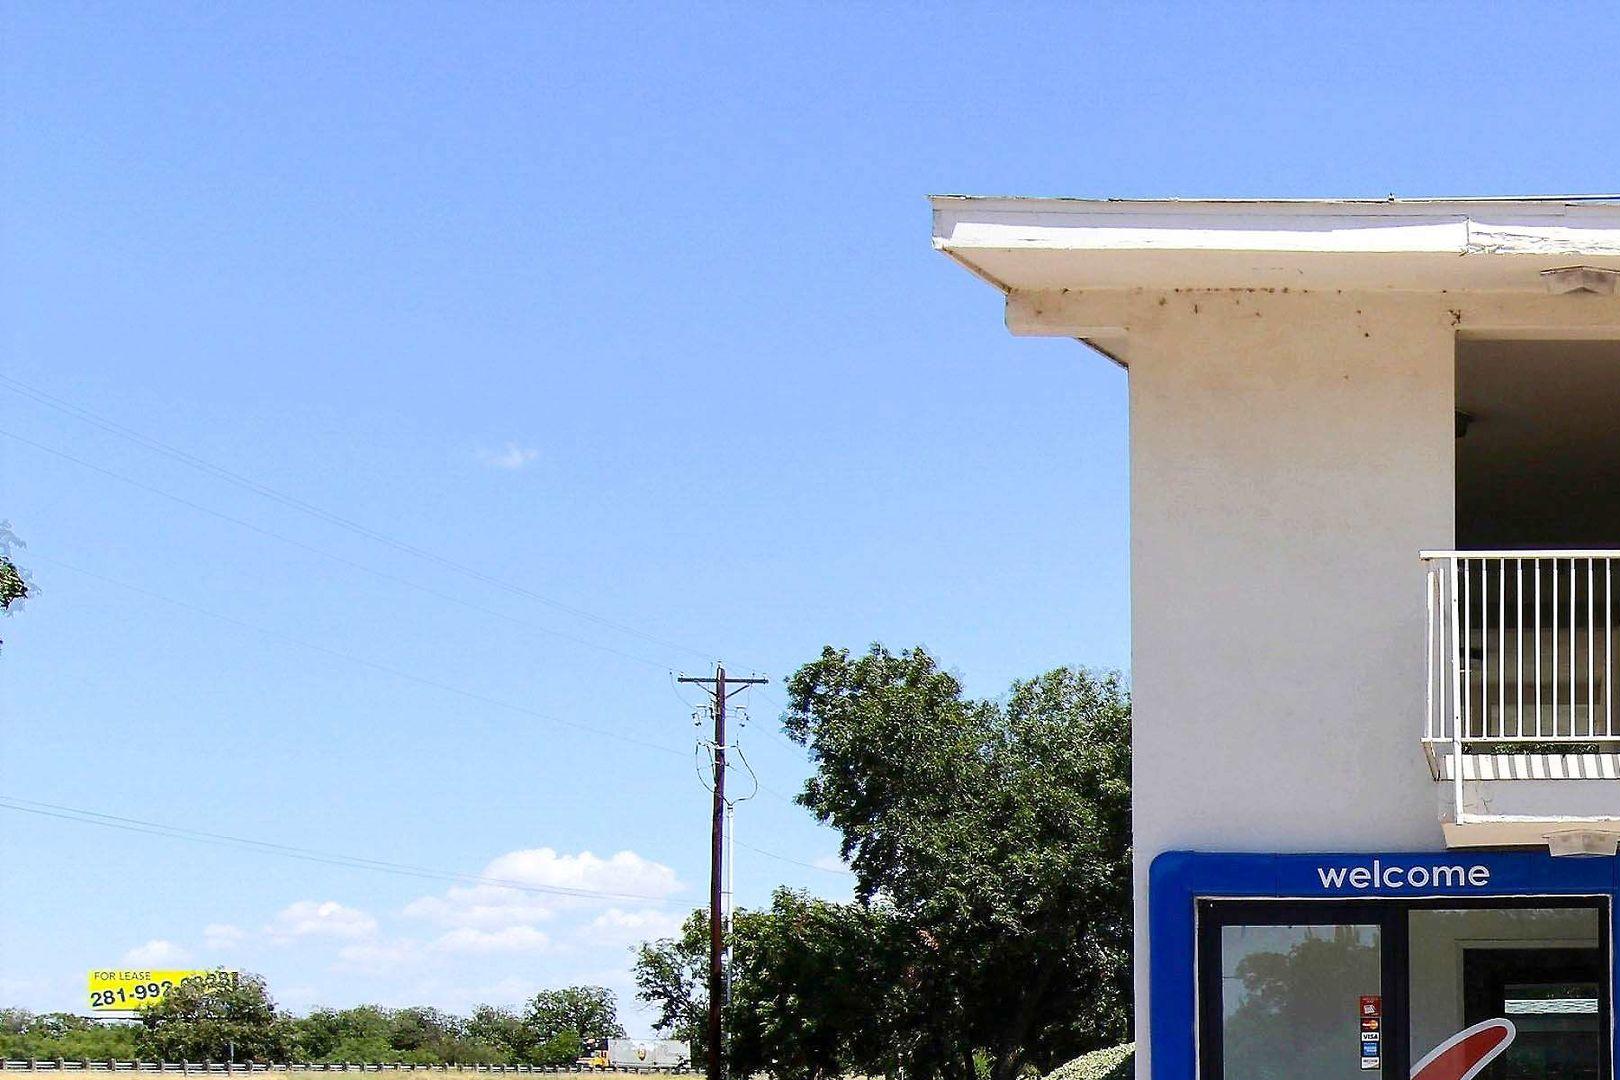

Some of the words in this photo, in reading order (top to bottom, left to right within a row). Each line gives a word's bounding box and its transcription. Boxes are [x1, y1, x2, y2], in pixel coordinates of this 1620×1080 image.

[1317, 860, 1490, 888] welcome
[94, 971, 116, 981] FOR
[119, 971, 151, 981] LEASE
